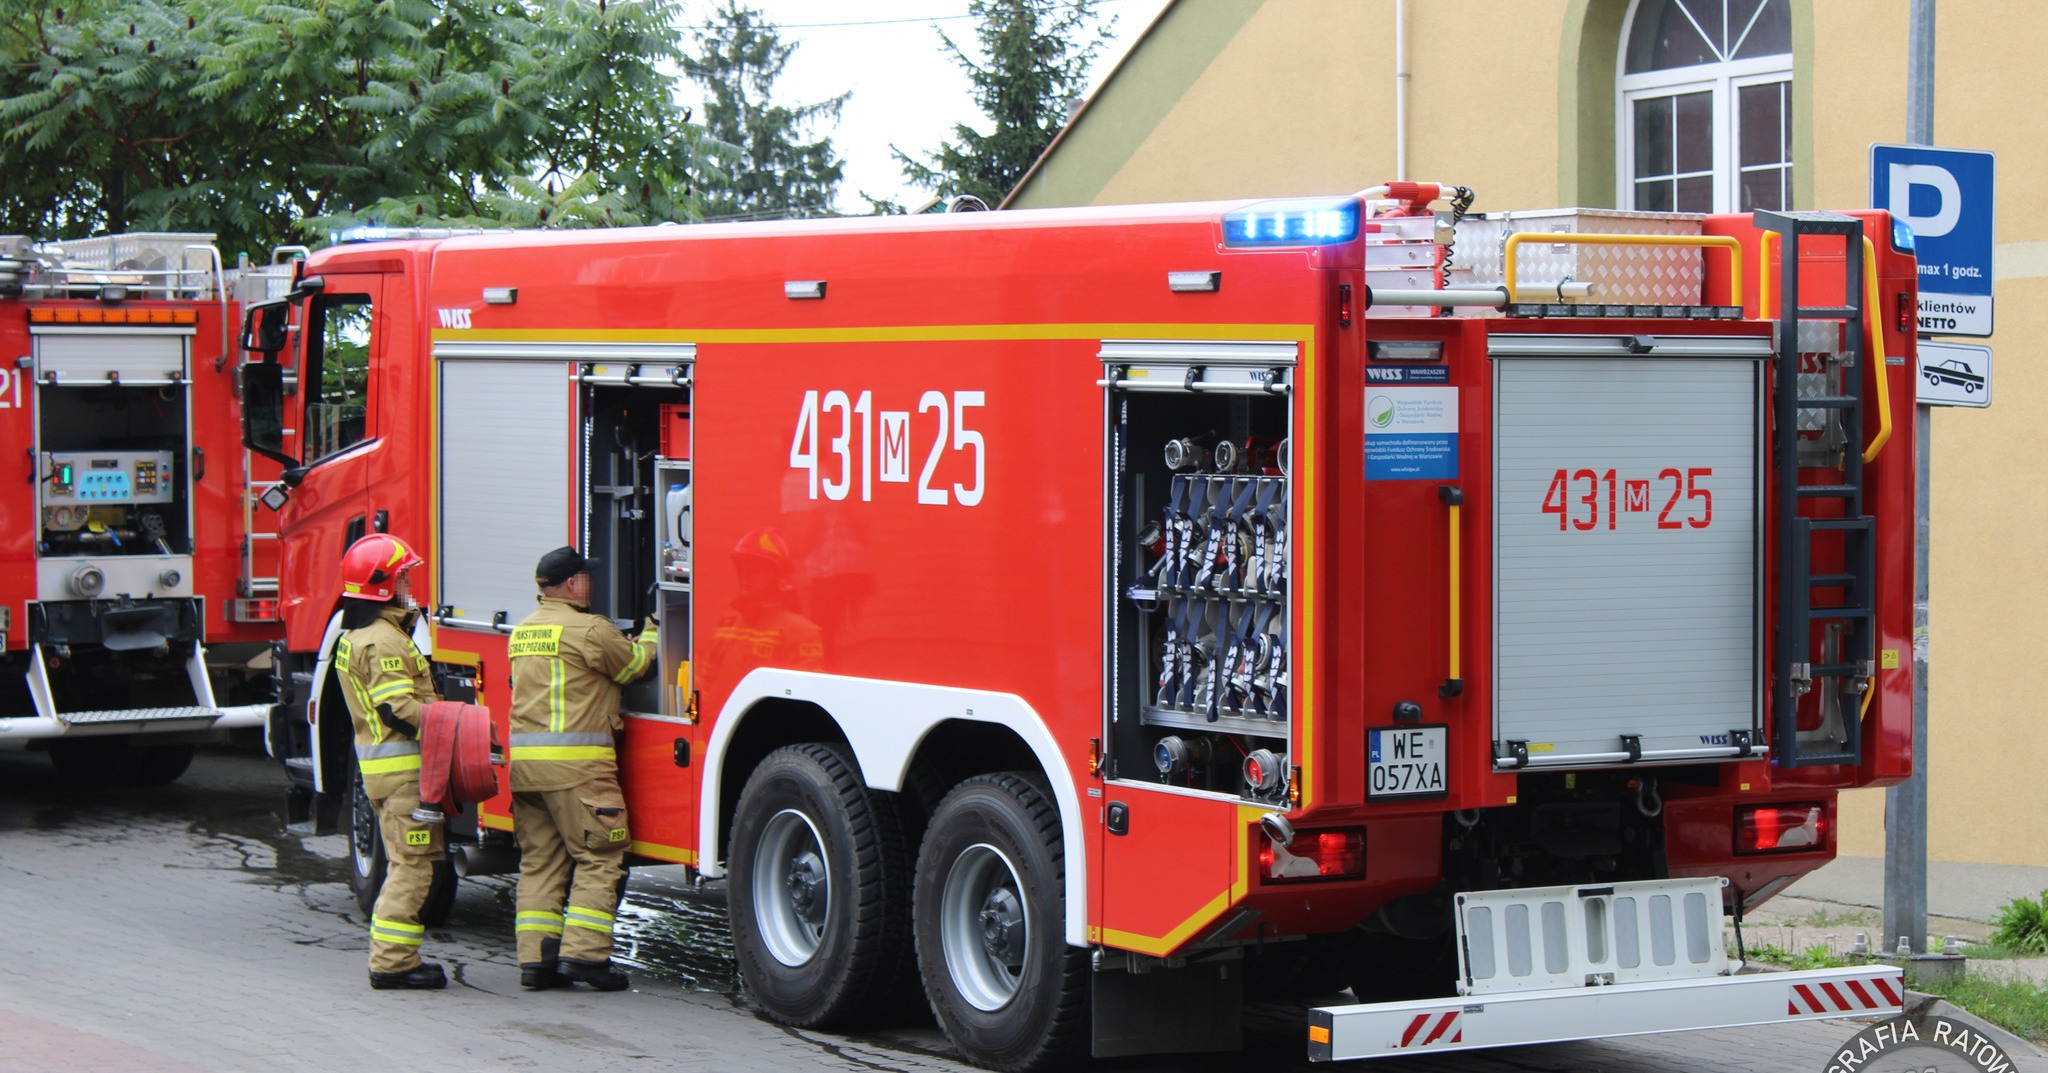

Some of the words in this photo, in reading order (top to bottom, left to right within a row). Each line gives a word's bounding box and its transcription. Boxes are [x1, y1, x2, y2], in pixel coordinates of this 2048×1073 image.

[1889, 163, 1961, 238] P
[1917, 264, 1940, 275] max
[1943, 263, 1949, 276] 1
[1952, 266, 1982, 280] godz.
[1917, 300, 1976, 315] klientów
[438, 308, 472, 329] WISS
[1917, 317, 1957, 329] NETTO
[1249, 371, 1267, 382] WIS
[1366, 368, 1402, 380] WISS
[790, 390, 872, 502] 431
[918, 391, 985, 507] 25
[1542, 469, 1616, 531] 431
[1658, 468, 1712, 529] 25
[383, 659, 400, 669] PSP
[1393, 732, 1423, 759] WE
[1700, 735, 1728, 745] WISS
[1371, 750, 1380, 758] PL
[409, 833, 427, 842] PSP
